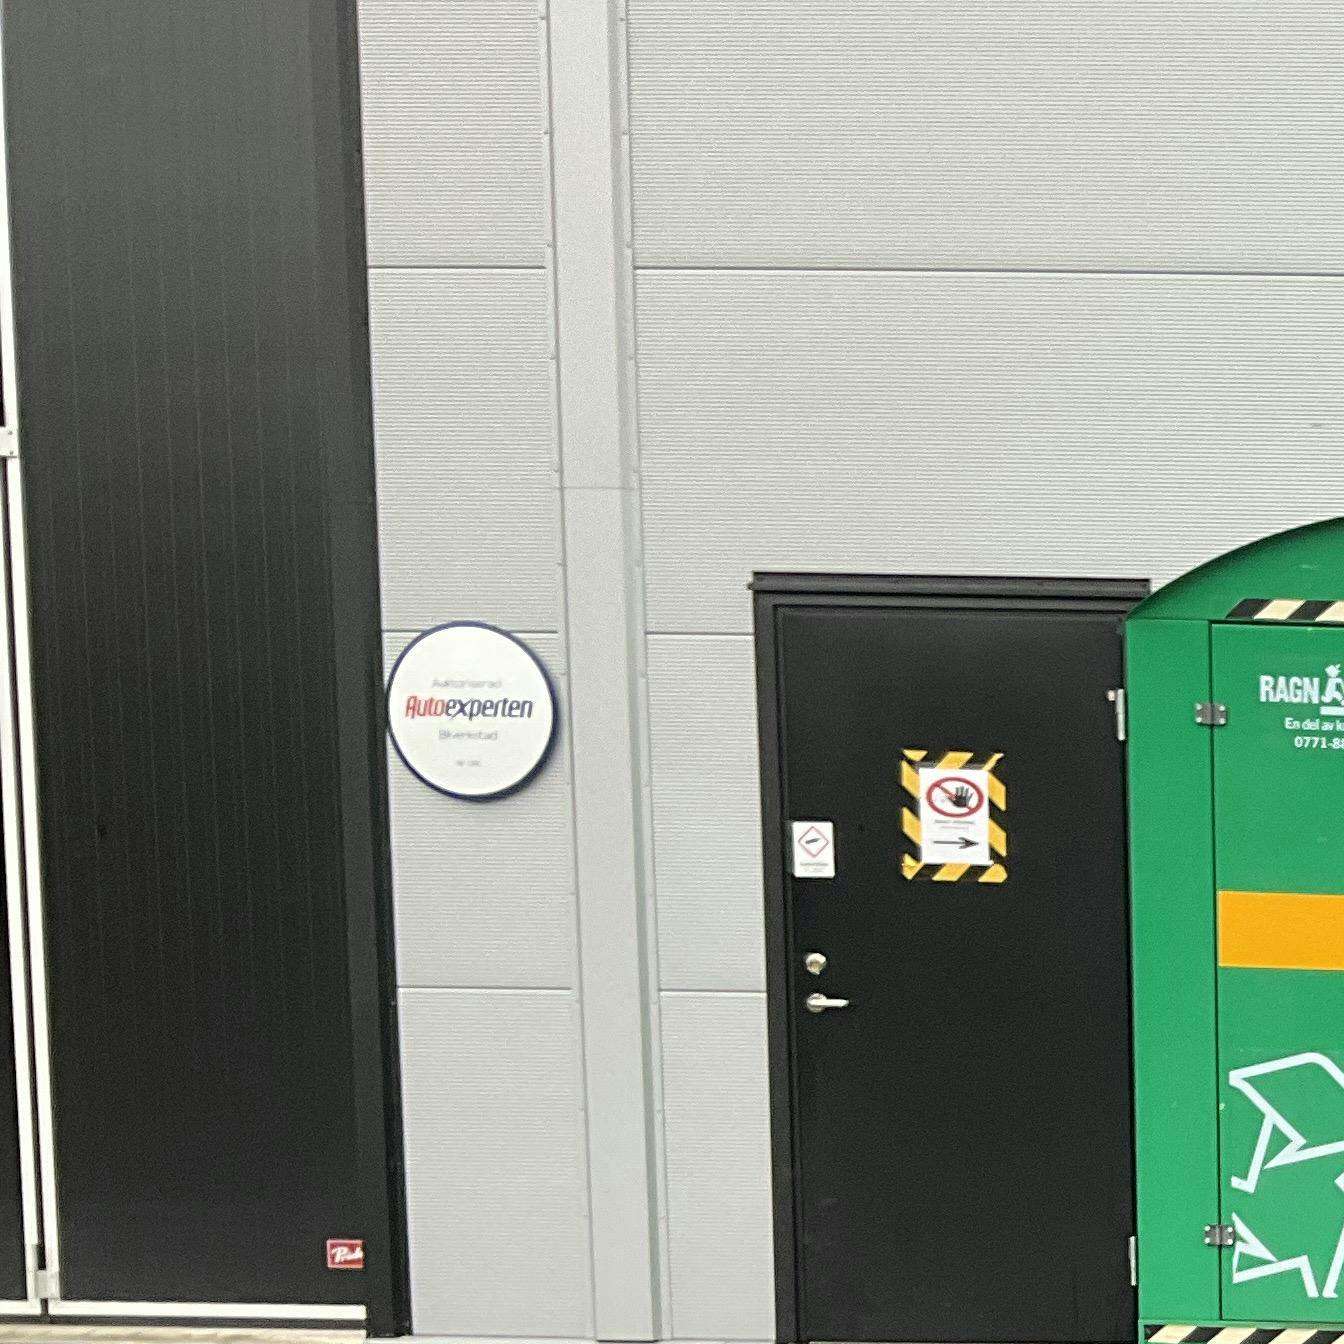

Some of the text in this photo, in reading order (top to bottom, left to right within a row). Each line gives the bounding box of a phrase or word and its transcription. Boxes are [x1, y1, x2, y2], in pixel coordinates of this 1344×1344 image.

[1259, 675, 1320, 704] RAGN
[405, 696, 534, 721] Autoexperten
[1284, 717, 1301, 730] En
[1302, 718, 1320, 731] del
[1321, 721, 1335, 731] av
